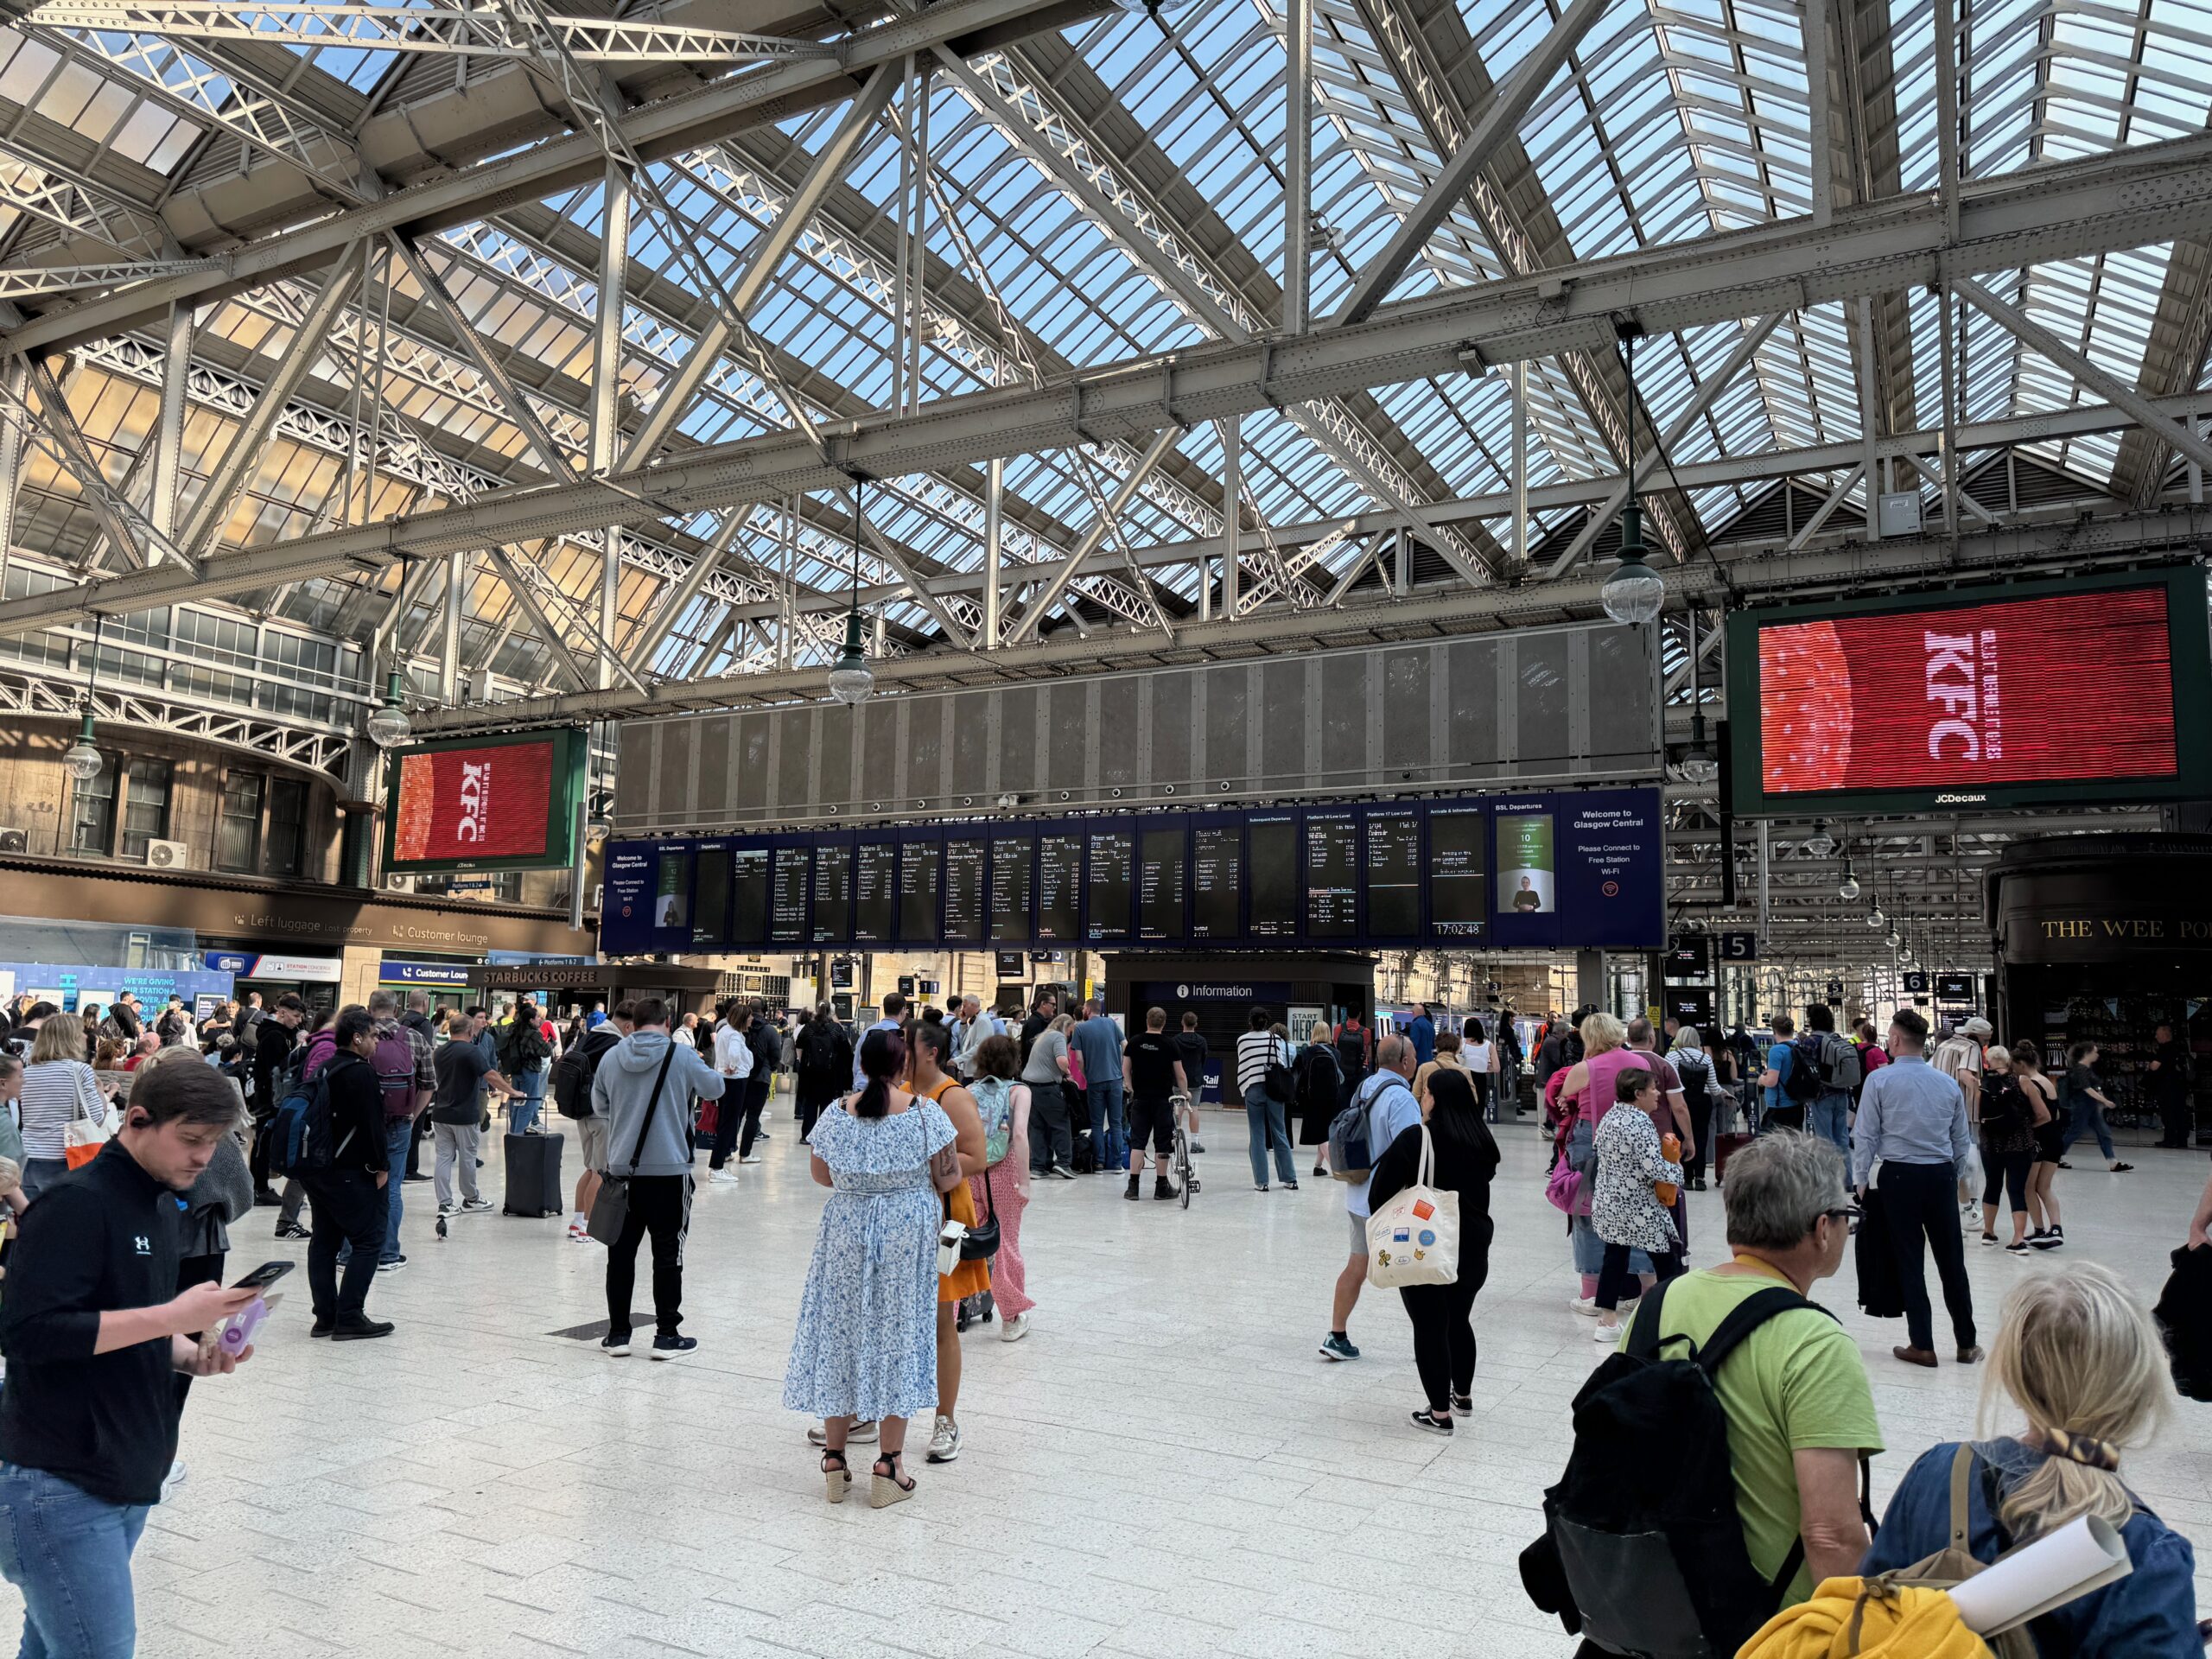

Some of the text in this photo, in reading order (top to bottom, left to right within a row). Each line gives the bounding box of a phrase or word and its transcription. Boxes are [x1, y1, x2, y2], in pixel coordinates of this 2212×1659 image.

[1924, 631, 1979, 761] KFC
[458, 761, 482, 842] KFC
[1935, 793, 1986, 804] JCDecaux
[1574, 818, 1643, 830] Glasgow Central
[251, 914, 274, 926] Left
[278, 915, 321, 931] luggage
[342, 925, 372, 936] property
[1438, 925, 1479, 935] 17:02:48
[2041, 920, 2093, 938] THE
[2101, 920, 2164, 937] WEE
[408, 926, 488, 944] Customer lounge
[1732, 937, 1745, 956] 5
[416, 969, 468, 981] Customer Loun
[484, 971, 595, 982] STARBUCKS COFFEE
[1492, 982, 1498, 991] 3
[1910, 976, 1921, 988] 6
[1193, 985, 1252, 997] Information
[1293, 1020, 1318, 1041] HER
